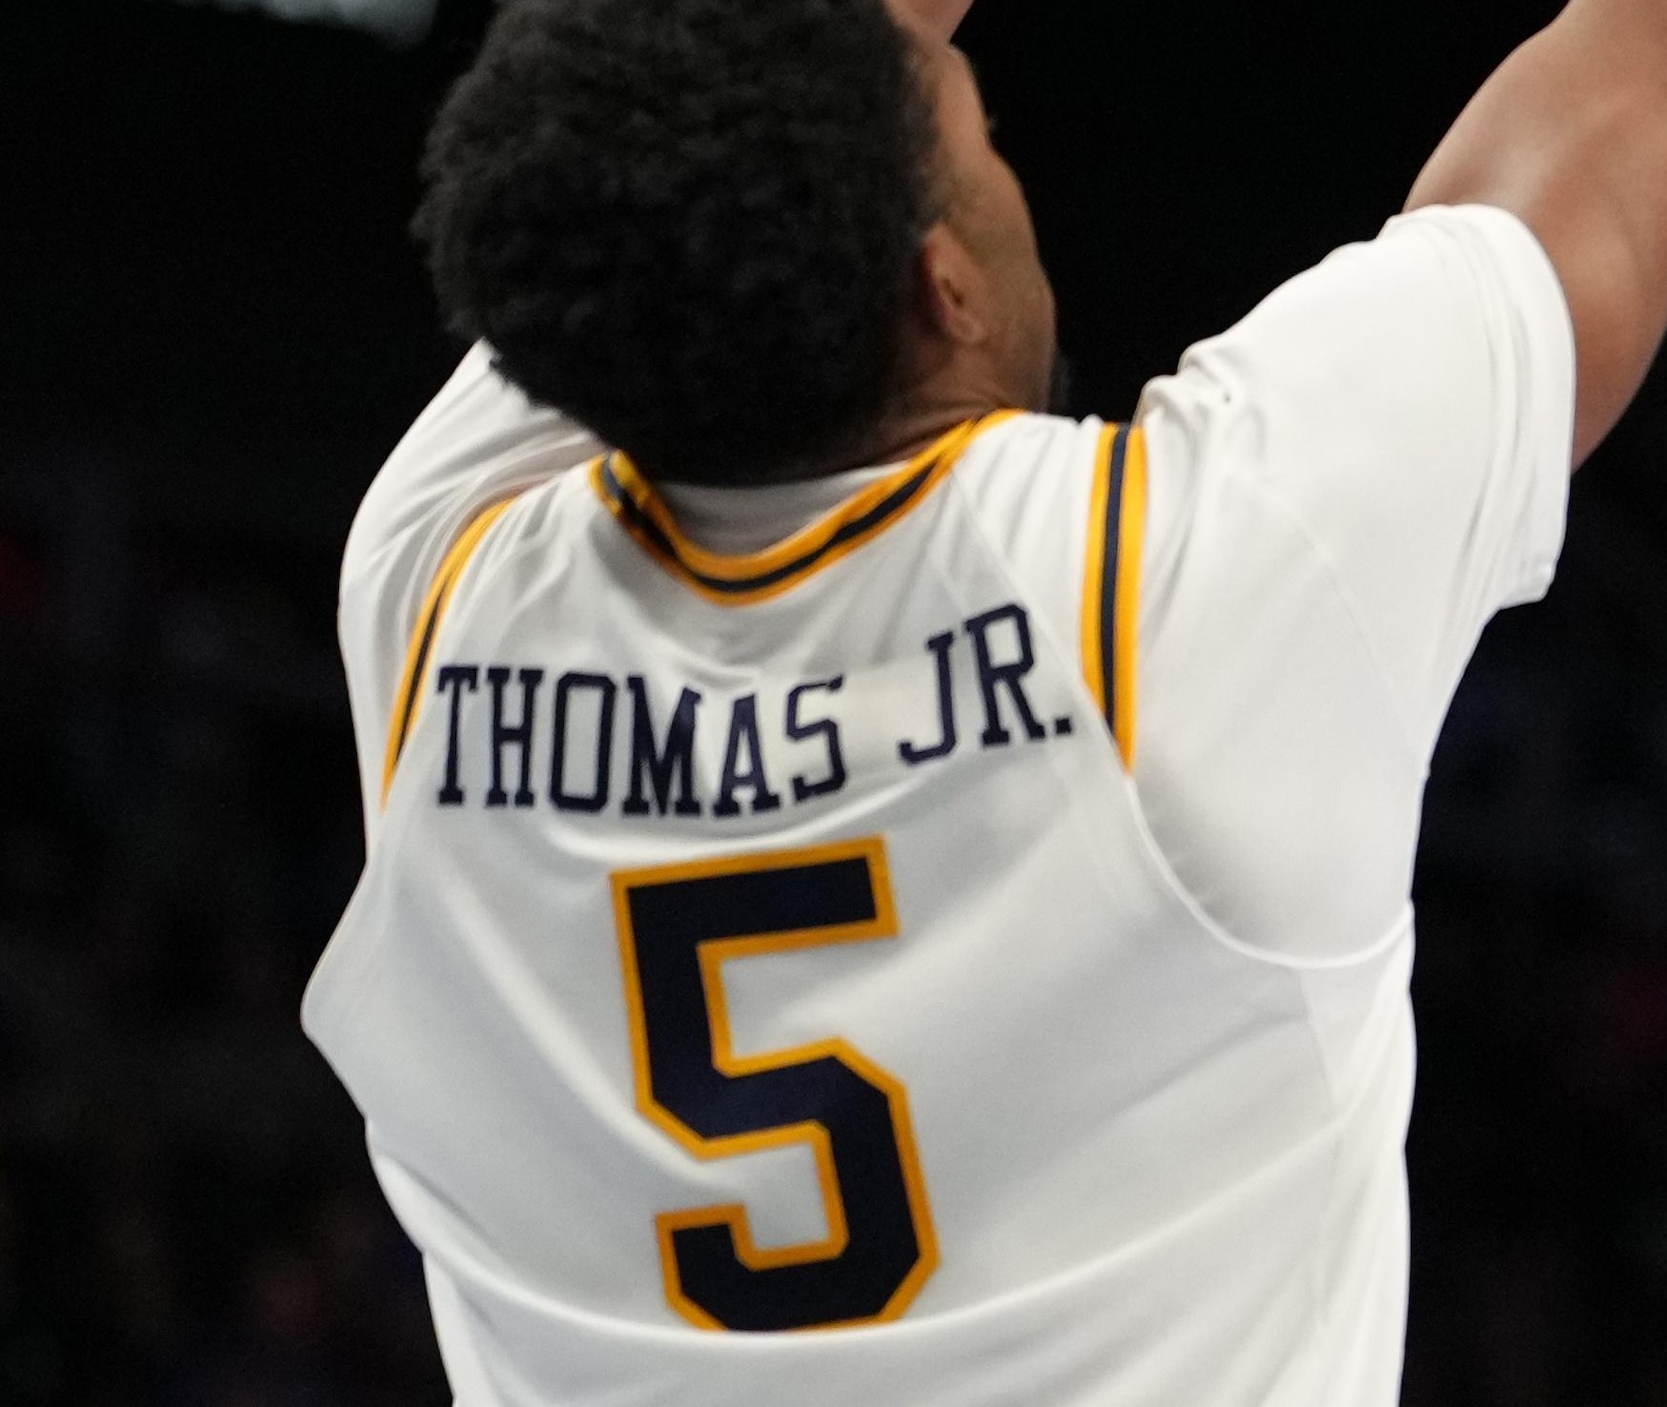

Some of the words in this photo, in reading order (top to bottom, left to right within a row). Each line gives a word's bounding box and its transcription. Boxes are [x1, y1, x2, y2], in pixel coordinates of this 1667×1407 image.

[436, 663, 847, 819] THOMAS
[899, 602, 1073, 766] JR.
[609, 834, 941, 1333] 5
